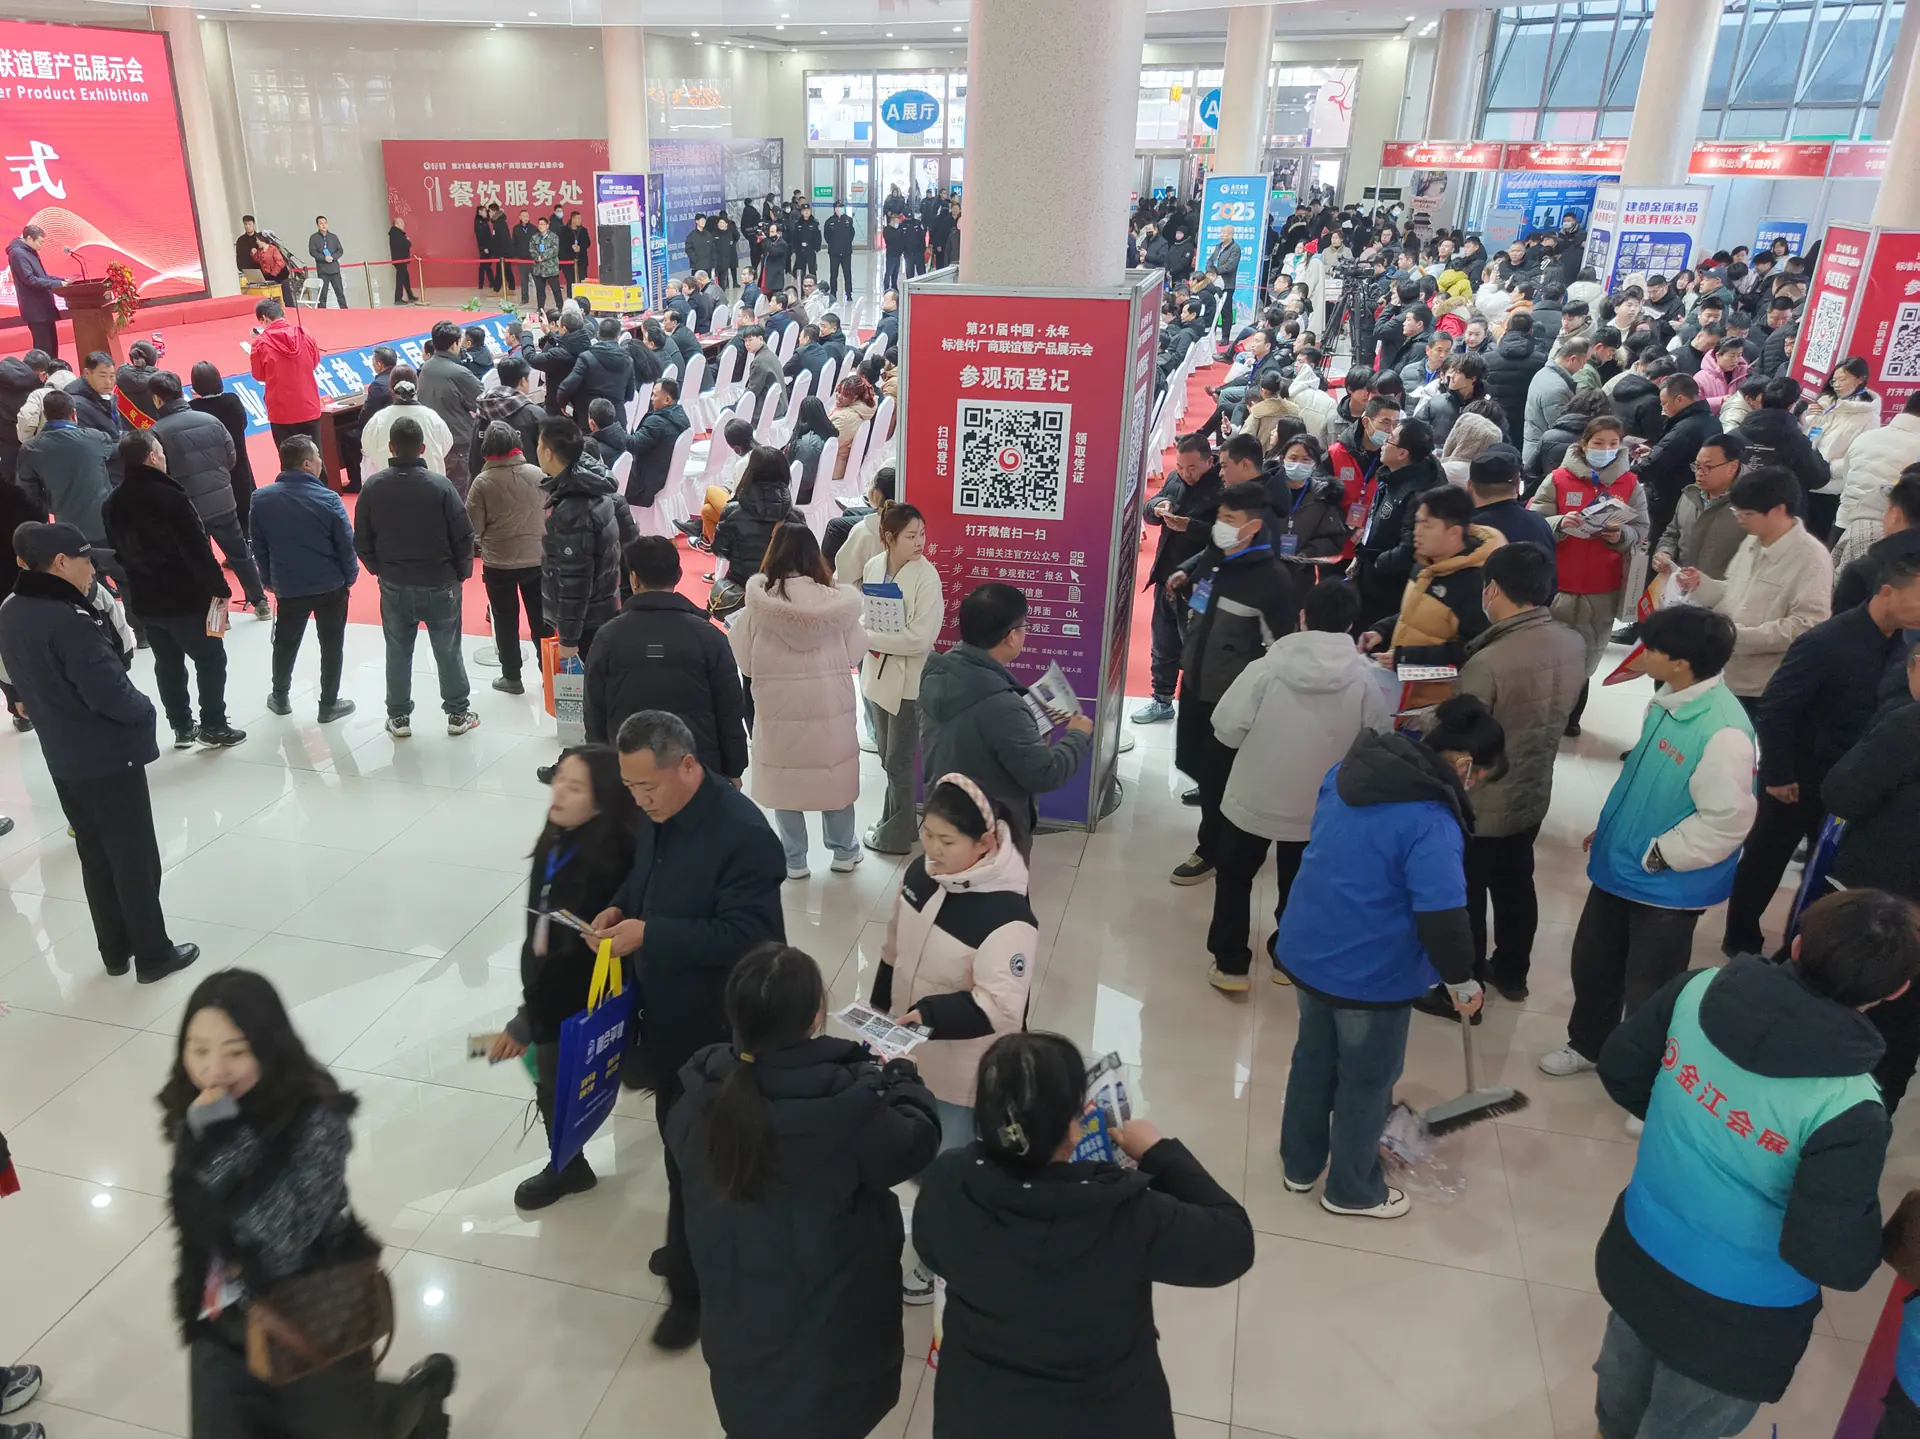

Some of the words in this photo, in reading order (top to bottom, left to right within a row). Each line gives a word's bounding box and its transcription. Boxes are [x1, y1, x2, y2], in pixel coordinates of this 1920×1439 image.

[17, 85, 76, 100] Product
[80, 87, 149, 102] Exhibition
[885, 102, 936, 121] A展厅
[5, 140, 67, 200] 式
[449, 179, 584, 208] 餐饮服务处
[1211, 201, 1255, 221] 2025
[1625, 202, 1699, 212] 建都金属制品
[1623, 214, 1697, 225] 制造有限公司
[966, 321, 1070, 339] 第21届中国·永年
[941, 338, 1094, 357] 标准件厂商联谊暨产品展示会
[959, 365, 1070, 392] 参观预登记
[936, 426, 949, 476] 扫码登记
[1072, 432, 1088, 484] 领取凭证
[965, 524, 1047, 541] 打开微信扫一扫
[926, 543, 964, 558] 第一步
[976, 547, 1061, 562] 扫描关注官方公众号
[1065, 608, 1079, 618] ok
[1027, 623, 1050, 633] 观证
[1676, 1064, 1789, 1154] 金江会展
